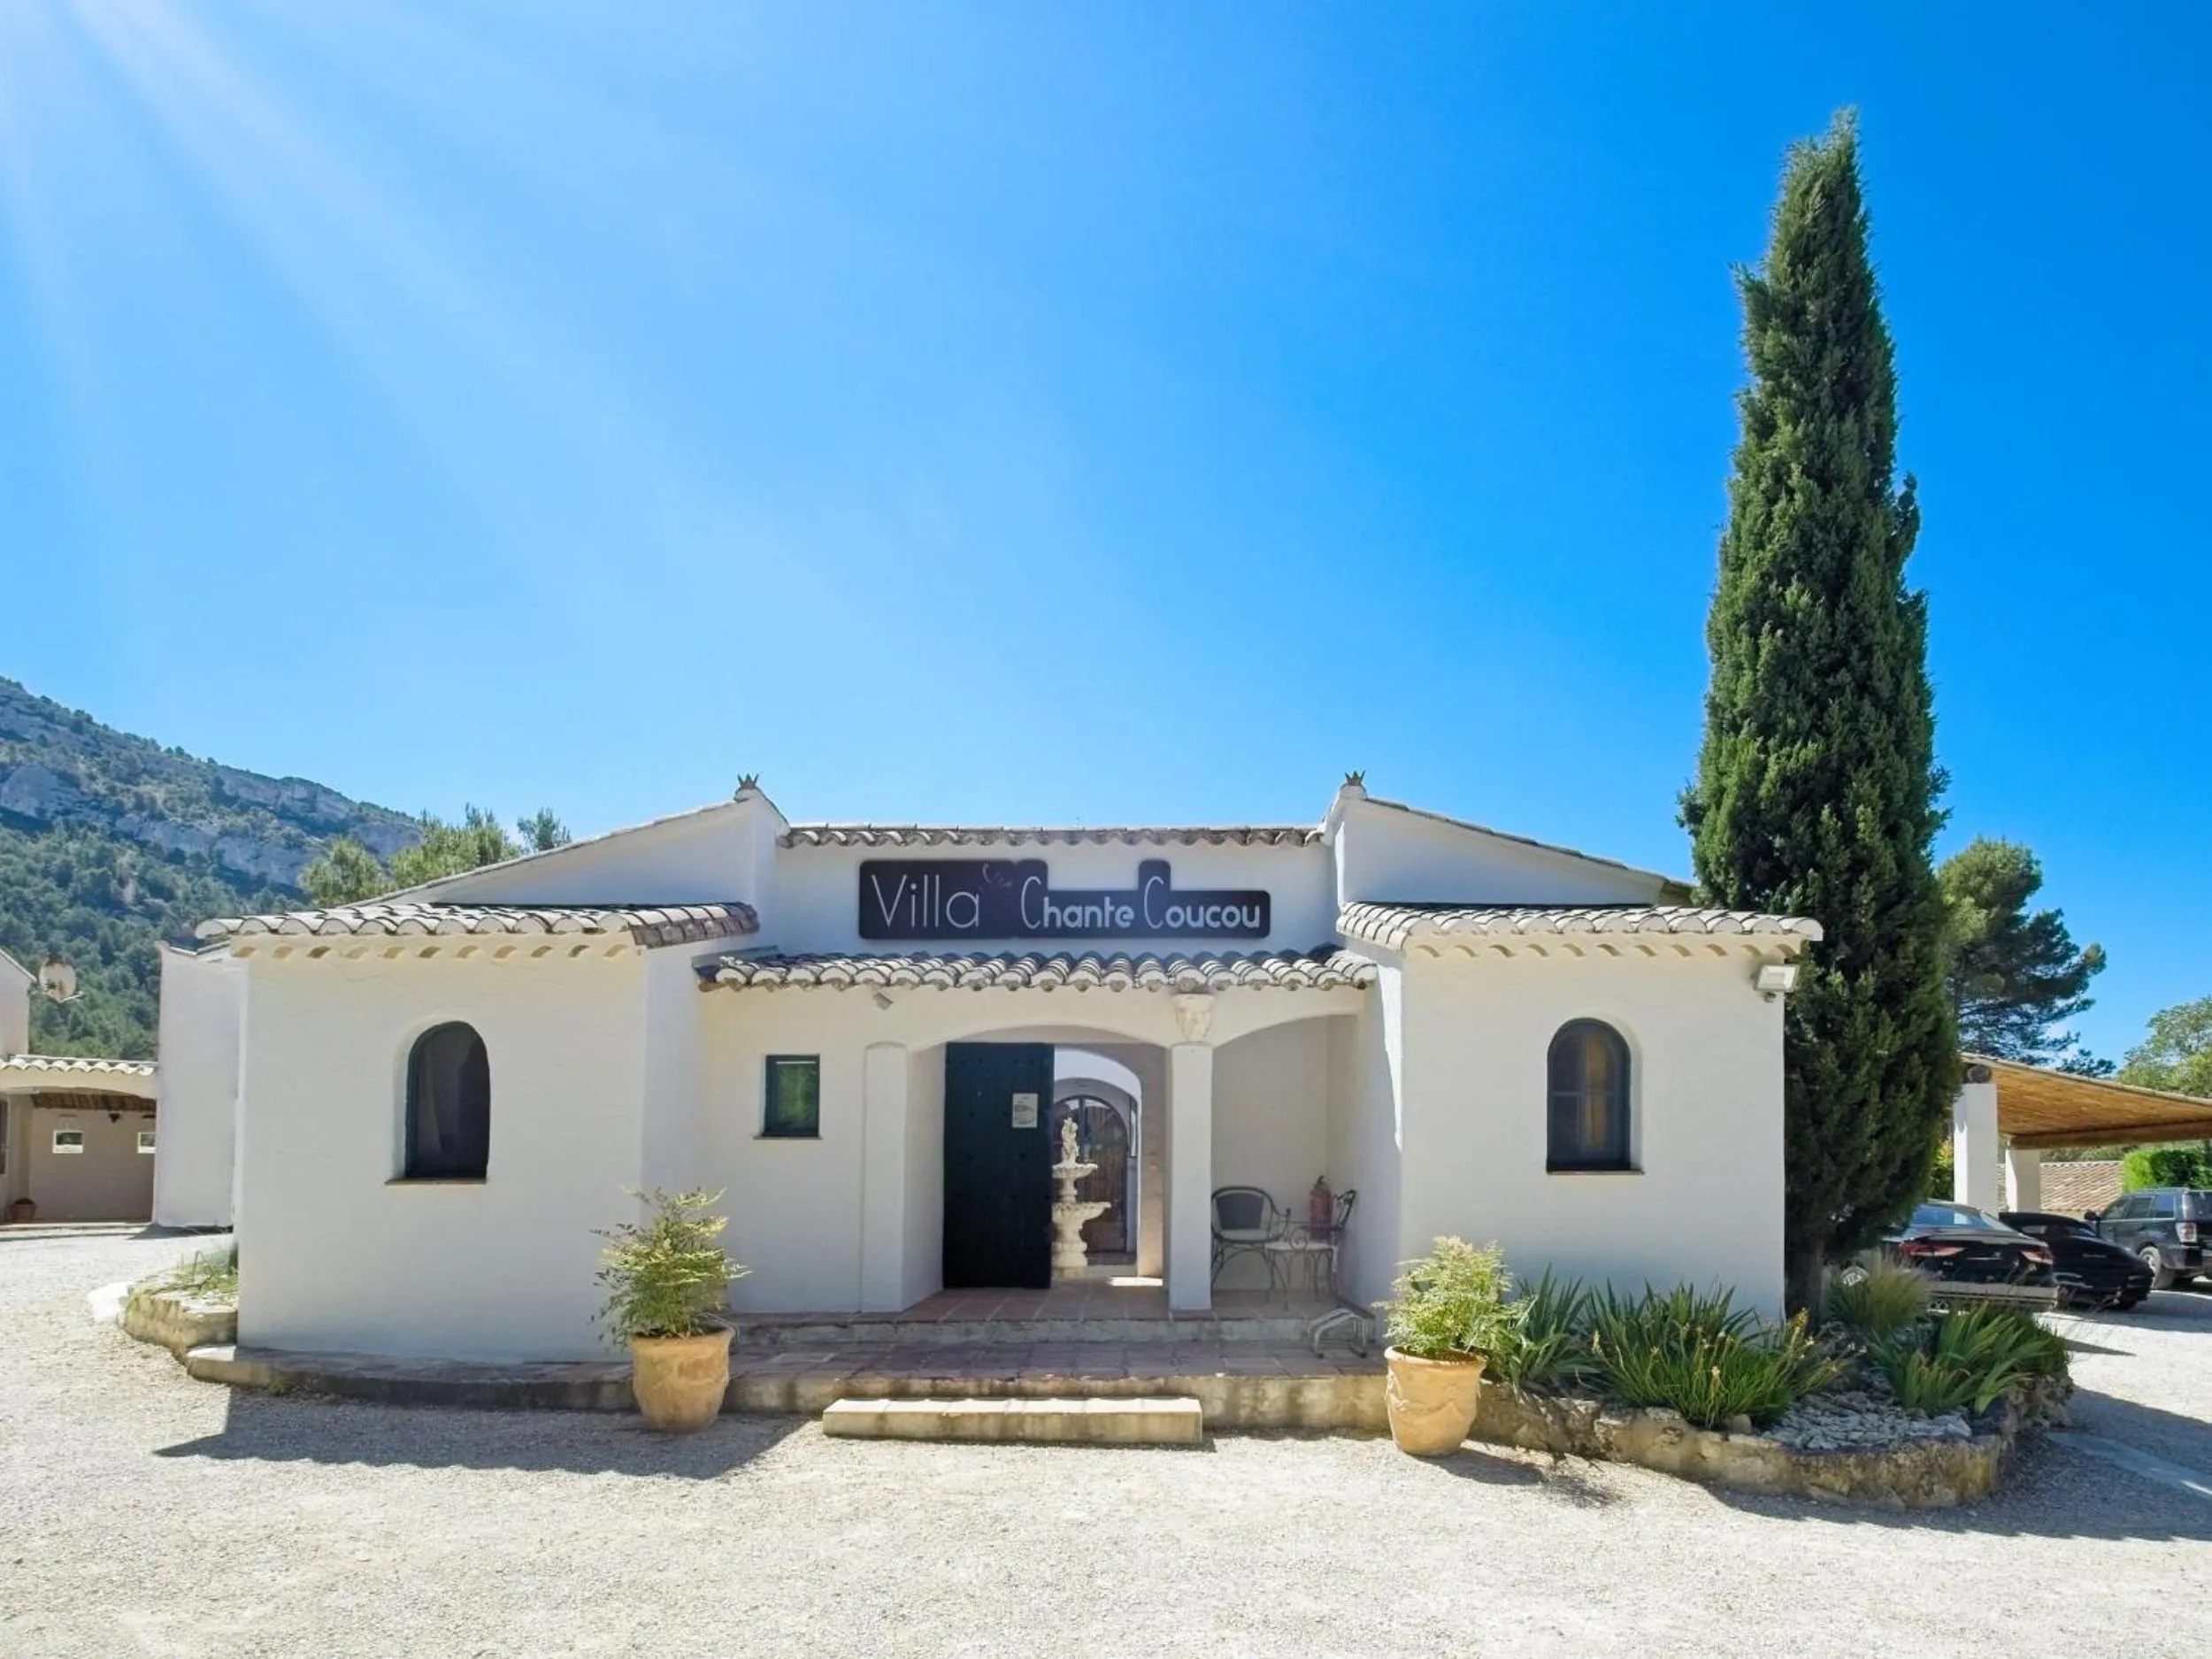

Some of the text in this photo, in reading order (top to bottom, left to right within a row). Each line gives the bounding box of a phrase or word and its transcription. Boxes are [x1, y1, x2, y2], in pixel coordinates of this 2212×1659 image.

[871, 873, 1261, 929] Villa Chante Coucou
